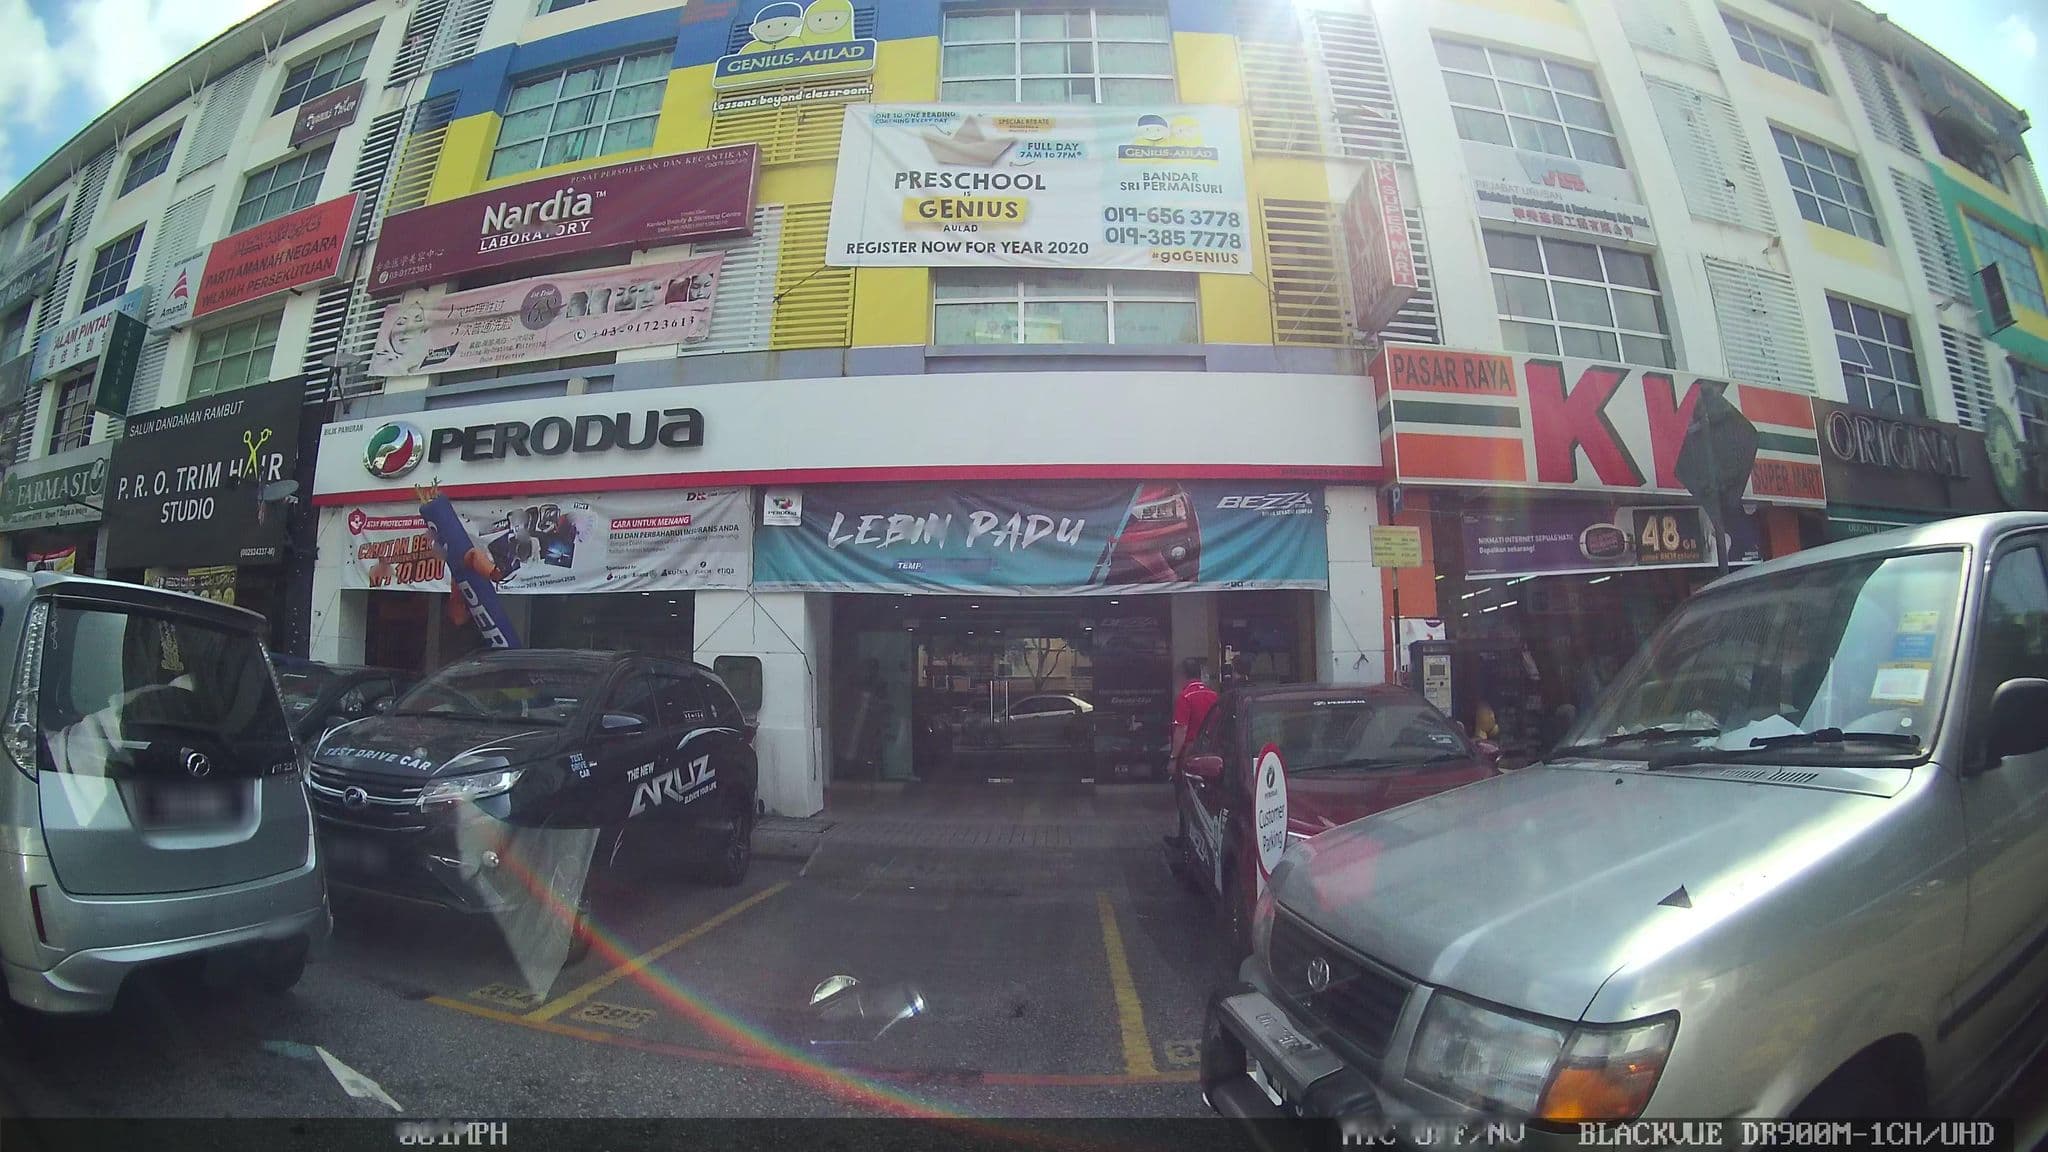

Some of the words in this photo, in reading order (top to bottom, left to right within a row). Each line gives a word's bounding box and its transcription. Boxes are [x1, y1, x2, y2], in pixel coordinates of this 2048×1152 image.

[727, 46, 865, 72] GENIUS-AULAD
[712, 97, 757, 112] Lessons
[760, 92, 803, 107] beyond
[805, 84, 873, 101] classroom!
[1027, 142, 1052, 151] FULL
[1056, 142, 1079, 151] DAY
[1125, 148, 1213, 159] GENIUS-AULAD
[570, 171, 599, 184] PUSAT
[663, 157, 682, 168] DAN
[685, 149, 750, 165] KECANTIKAN
[1142, 172, 1200, 182] BANDAR
[894, 171, 1046, 190] PRESCHOOL
[1120, 182, 1140, 191] SRI
[1143, 182, 1223, 194] PERMAISURI
[481, 187, 593, 235] Nardia
[918, 199, 1019, 219] GENIUS
[1104, 206, 1185, 225] 019-656
[1190, 210, 1241, 228] 3778
[480, 220, 592, 252] LABORAORY
[943, 224, 978, 233] AULAD
[1105, 227, 1186, 246] 019-385
[1190, 230, 1242, 249] 7778
[846, 241, 917, 254] REGISTER
[921, 241, 962, 253] NOW
[965, 241, 996, 254] FOR
[1001, 241, 1044, 254] YEAR
[1048, 241, 1089, 255] 2020
[1151, 251, 1239, 264] #goGENIUS
[205, 270, 235, 289] PARTI
[235, 251, 285, 279] AMANAH
[285, 234, 338, 262] NEGARA
[246, 256, 333, 292] PERSEKUTUAN
[160, 300, 188, 318] Amanah
[1393, 353, 1459, 388] PASAR
[1464, 358, 1512, 391] RAYA
[129, 419, 154, 437] SALUN
[155, 411, 201, 432] DANDANAN
[203, 400, 245, 420] RAMBUT
[16, 470, 90, 507] FARMASI
[118, 477, 129, 500] P.
[134, 474, 148, 498] R.
[154, 470, 169, 495] O.
[176, 461, 222, 493] TRIM
[160, 496, 215, 524] STUDIO
[1216, 489, 1313, 511] BEZZA
[609, 532, 623, 540] BELI
[624, 531, 639, 539] DAN
[640, 529, 683, 538] PERBAHARUI
[719, 524, 739, 532] ANDA
[612, 520, 632, 529] CARA
[632, 518, 656, 527] UNTUK
[657, 516, 690, 526] MENANG
[967, 510, 1085, 551] PADU
[1641, 515, 1681, 551] 48
[1683, 538, 1697, 550] GB
[324, 747, 356, 757] TEST
[355, 749, 399, 762] DRIVE
[400, 755, 432, 771] CAR
[570, 753, 583, 762] TEST
[579, 769, 591, 779] CAR
[627, 769, 640, 783] THE
[640, 761, 655, 778] NEW
[628, 754, 716, 818] ARUZ
[1259, 803, 1285, 830] Customer
[1262, 829, 1285, 855] Parking
